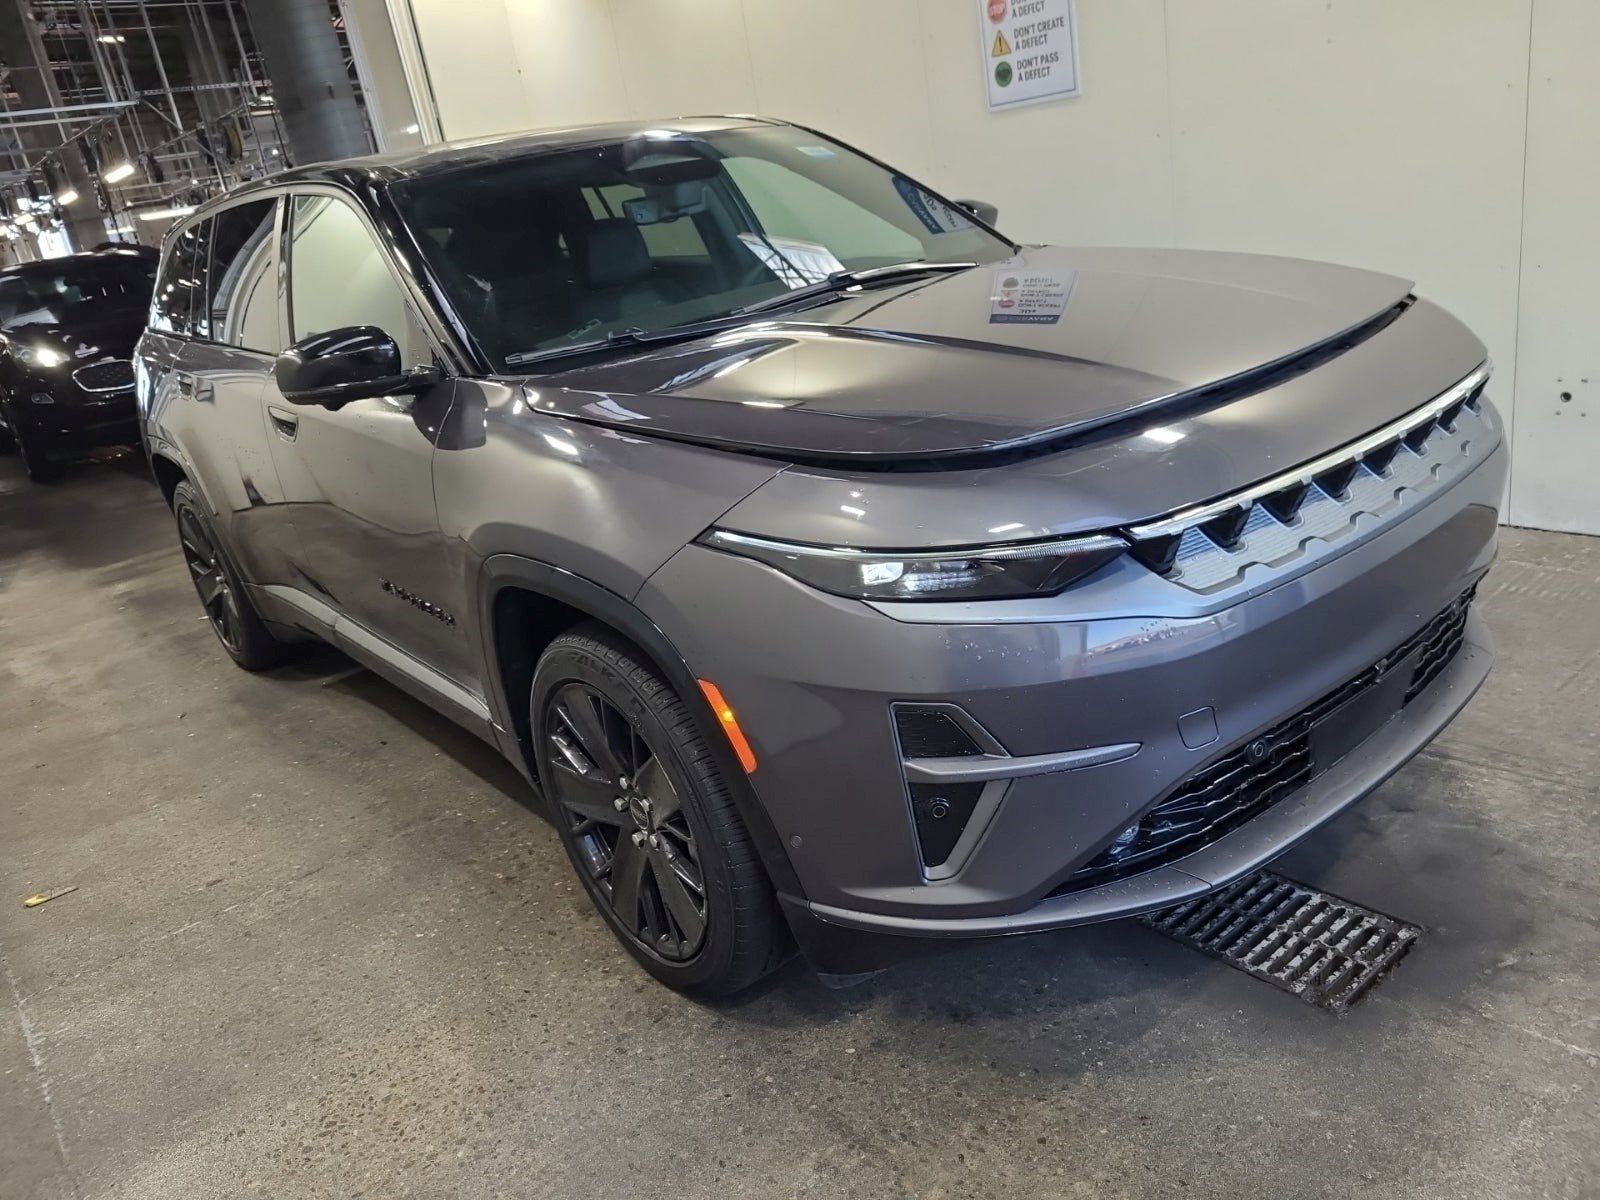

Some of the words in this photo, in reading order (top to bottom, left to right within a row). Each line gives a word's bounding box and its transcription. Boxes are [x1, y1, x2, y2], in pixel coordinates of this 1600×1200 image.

[1012, 8, 1017, 19] A
[1018, 0, 1045, 17] DEFECT
[1013, 24, 1035, 38] DON'T
[1037, 17, 1064, 32] CREATE
[1015, 41, 1021, 51] A
[1022, 34, 1047, 49] DEFECT
[1017, 57, 1038, 70] DON'T
[1040, 52, 1059, 64] PASS
[1018, 72, 1023, 82] A
[1025, 66, 1050, 81] DEFECT
